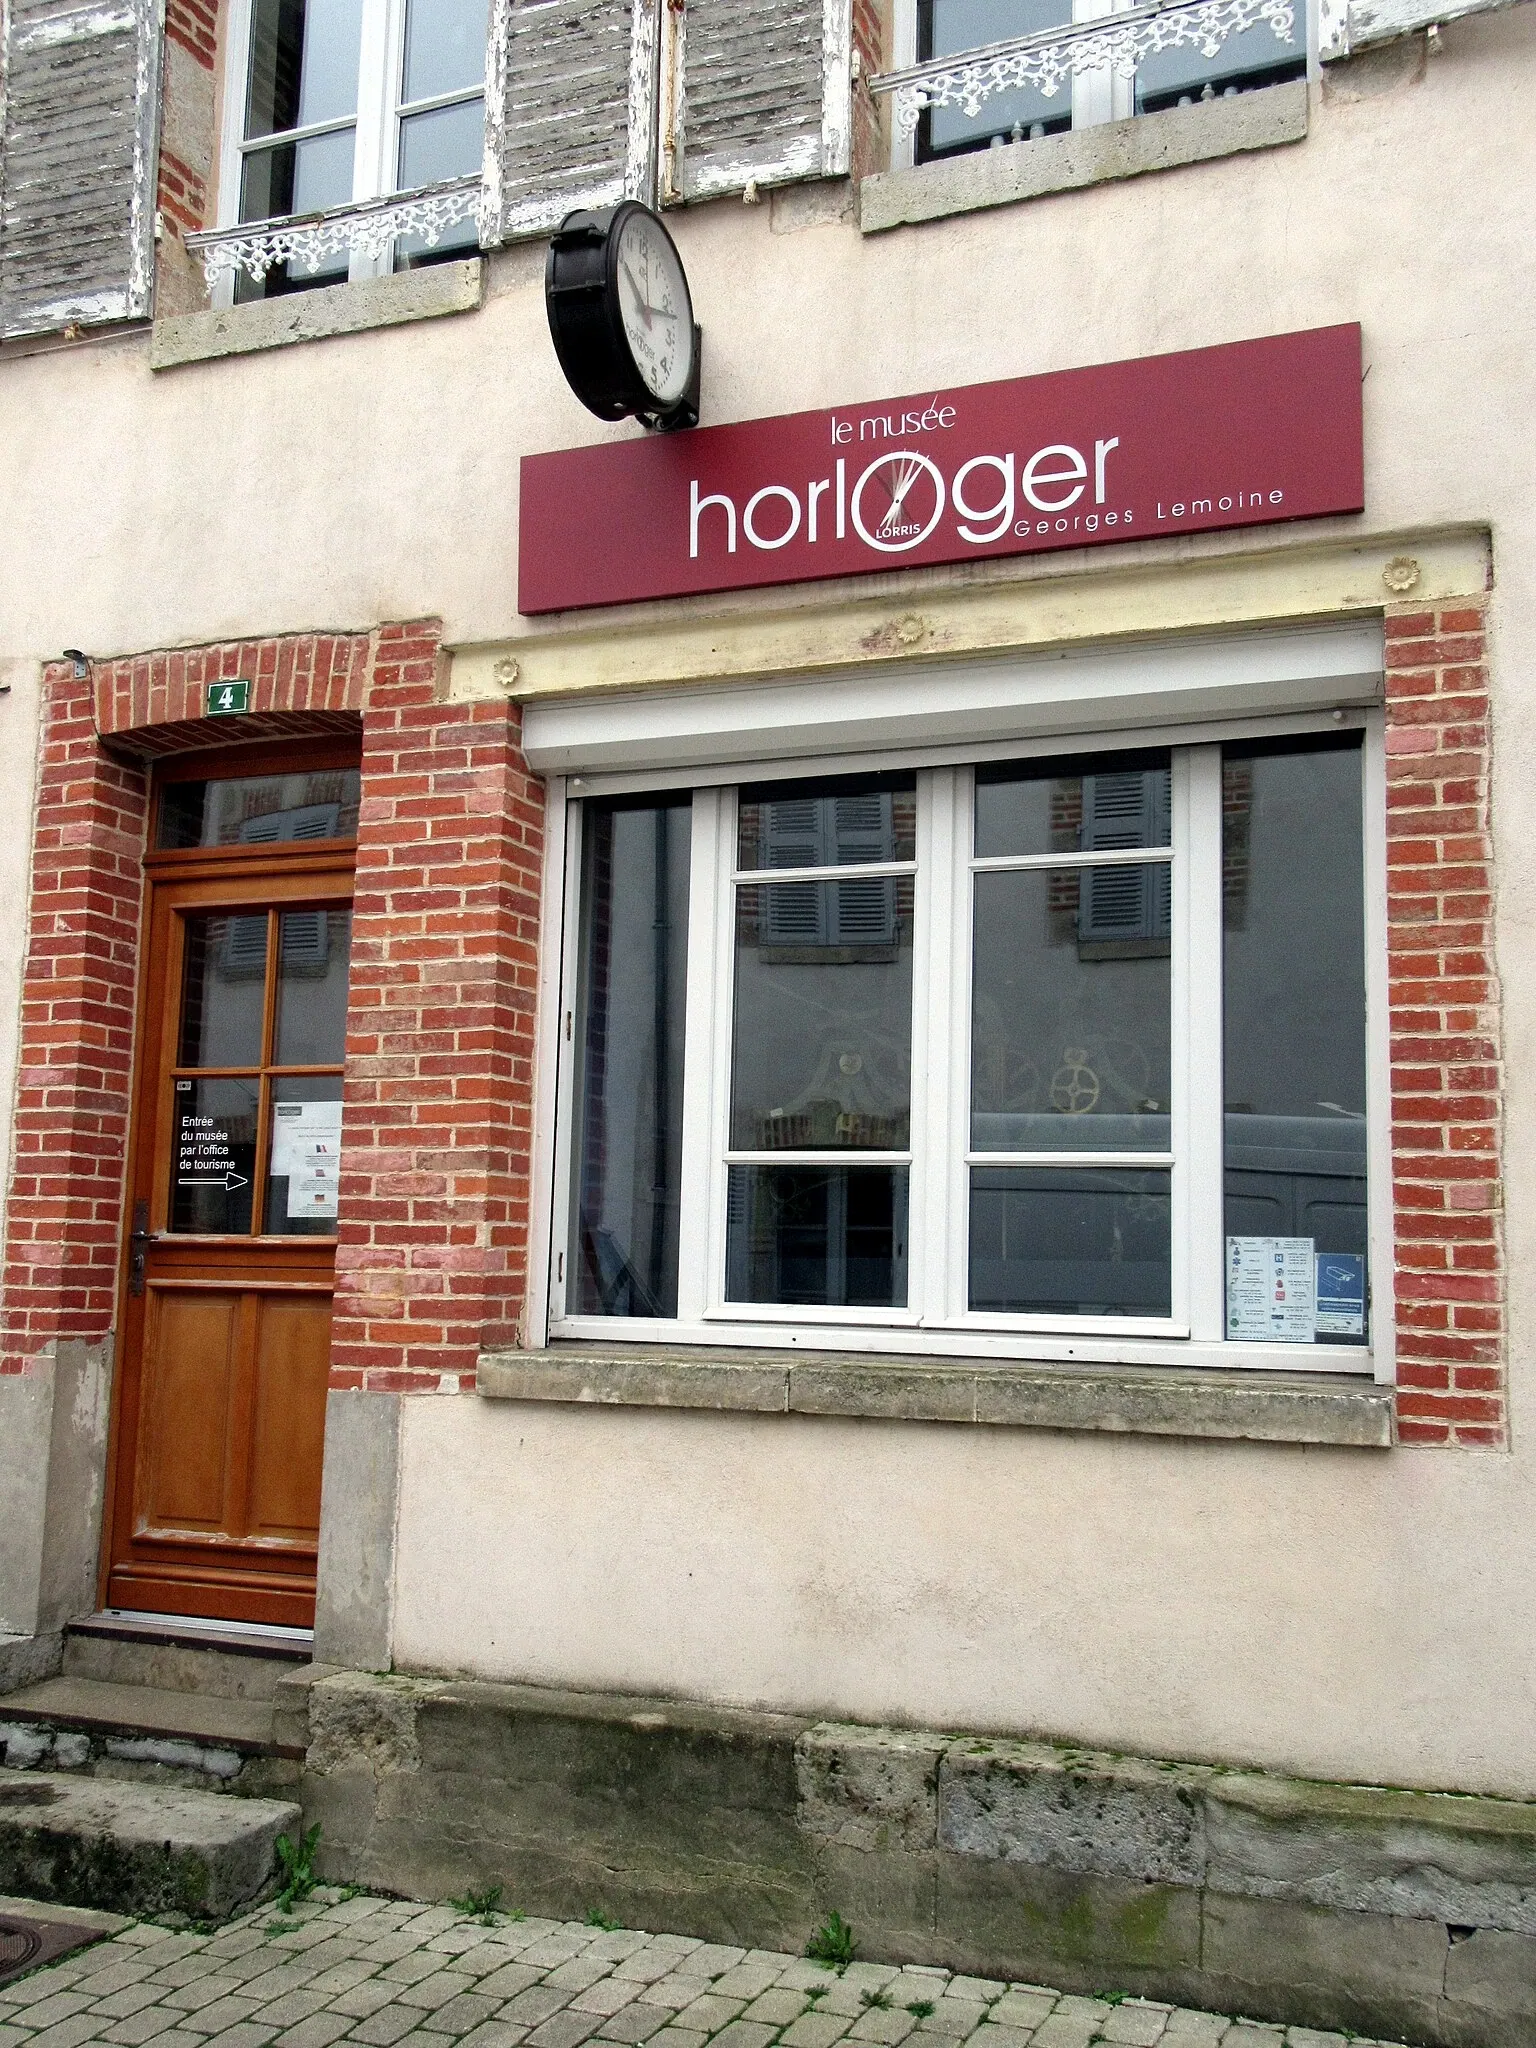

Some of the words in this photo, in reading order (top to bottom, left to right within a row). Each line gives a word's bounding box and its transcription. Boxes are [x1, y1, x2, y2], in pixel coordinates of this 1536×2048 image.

[665, 328, 672, 347] 3
[651, 366, 658, 385] 5
[660, 356, 670, 376] 4
[831, 416, 852, 444] le
[859, 394, 956, 441] musée
[1014, 508, 1133, 538] Georges
[1156, 488, 1284, 520] Lemoine
[876, 522, 921, 540] LORRIS
[218, 686, 234, 709] 4
[182, 1115, 214, 1127] Entrée
[181, 1130, 194, 1141] du
[195, 1129, 228, 1141] musée
[180, 1146, 197, 1158] par
[198, 1144, 229, 1155] l'office
[179, 1159, 192, 1170] de
[194, 1158, 236, 1170] tourisme
